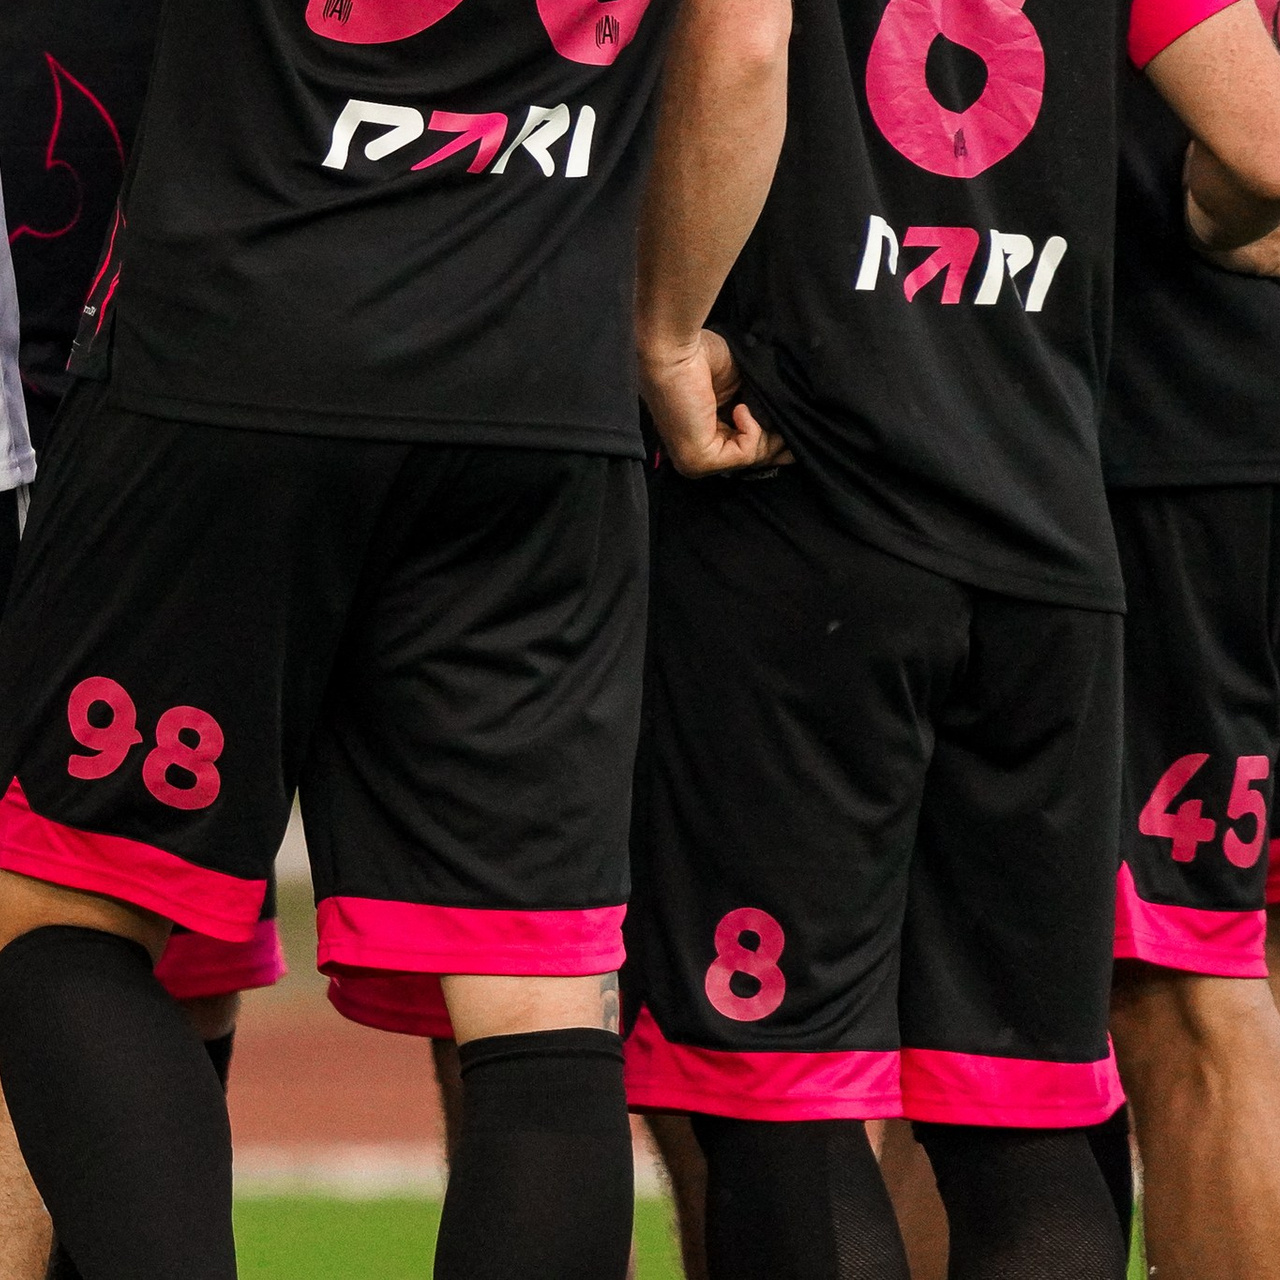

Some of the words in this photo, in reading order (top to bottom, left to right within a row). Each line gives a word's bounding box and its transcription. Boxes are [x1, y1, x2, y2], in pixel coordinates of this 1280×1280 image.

[321, 99, 596, 179] PARI
[67, 676, 225, 811] 98
[1138, 753, 1270, 868] 45
[705, 907, 786, 1022] 8
